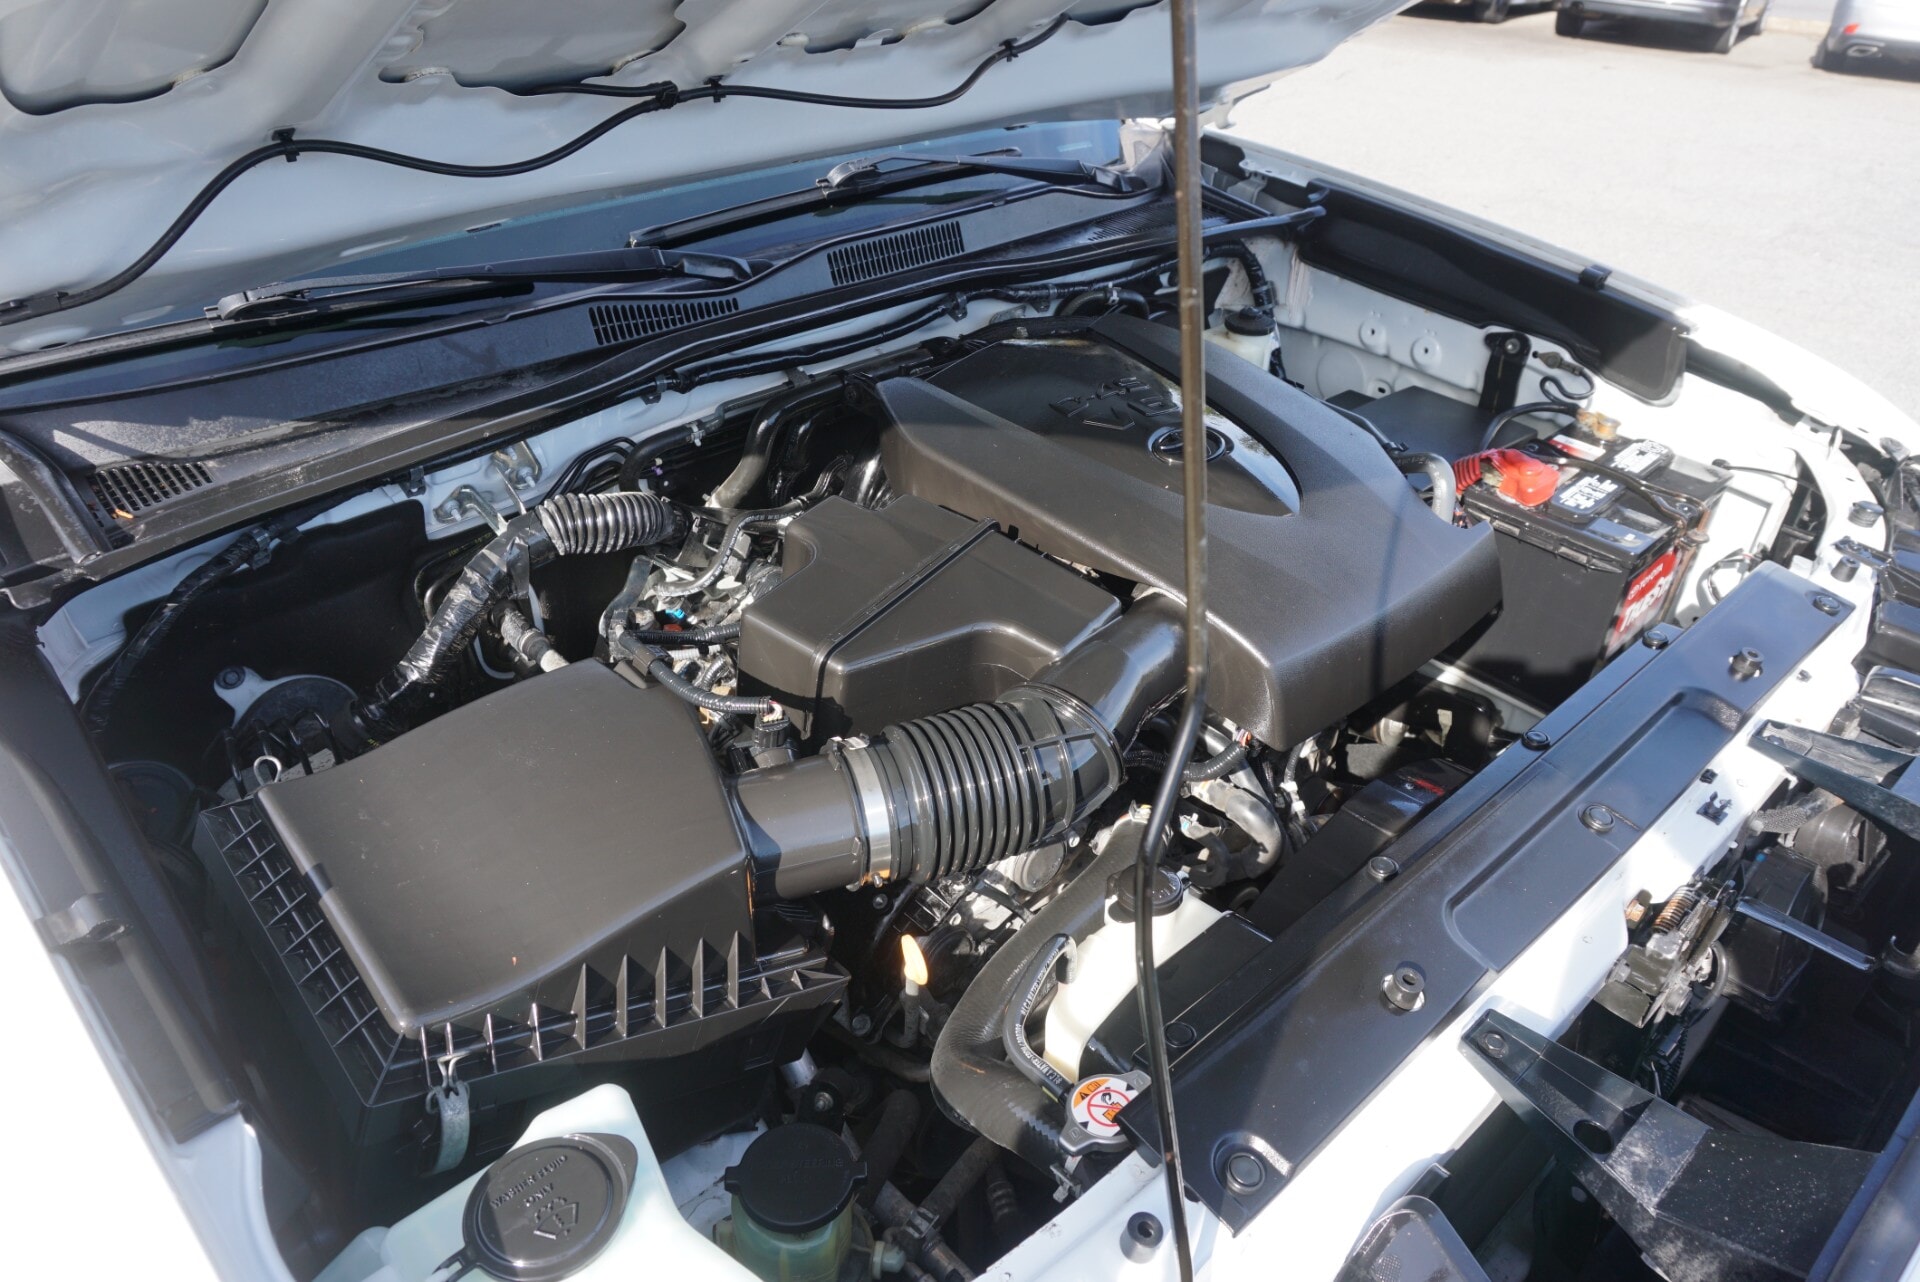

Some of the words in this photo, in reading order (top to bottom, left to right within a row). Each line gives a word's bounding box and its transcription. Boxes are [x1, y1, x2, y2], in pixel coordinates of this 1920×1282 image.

[490, 1175, 535, 1209] WASHER
[537, 1155, 568, 1179] FLUID
[524, 1182, 554, 1207] ONLY
